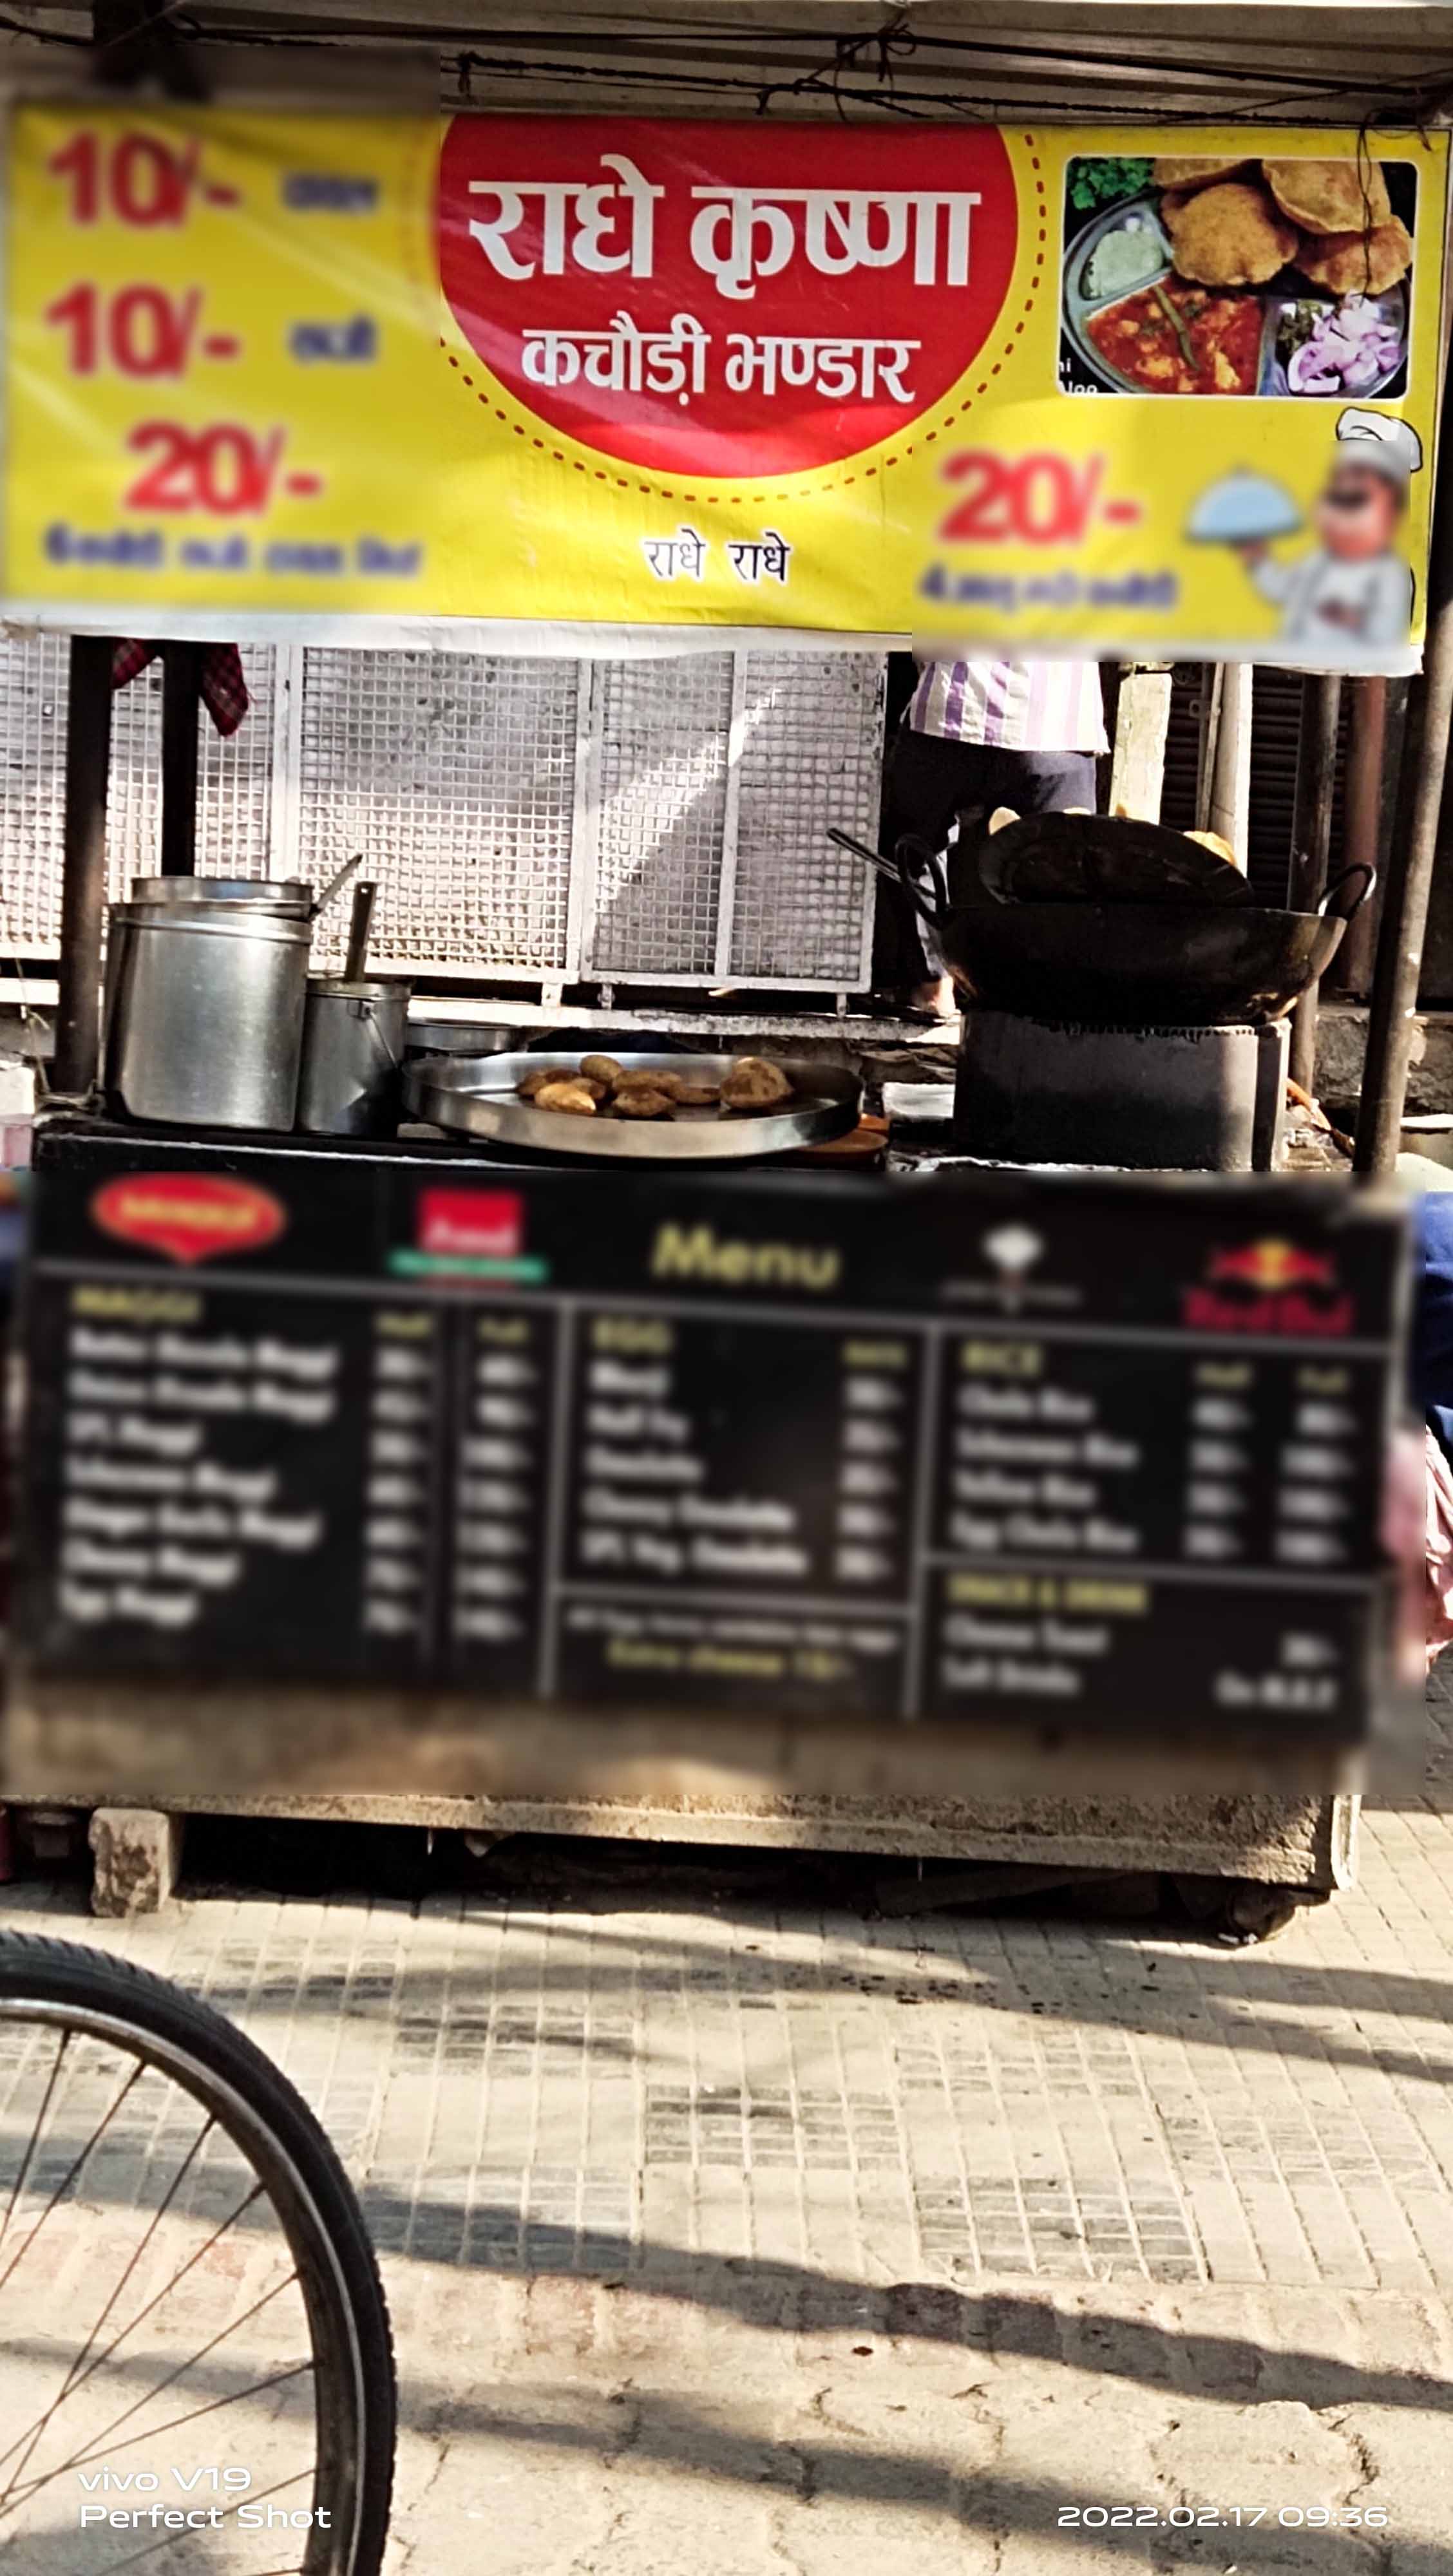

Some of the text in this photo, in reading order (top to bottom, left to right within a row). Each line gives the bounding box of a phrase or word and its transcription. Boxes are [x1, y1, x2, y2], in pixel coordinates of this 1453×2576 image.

[468, 154, 982, 300] राधे कृष्णा
[520, 310, 922, 406] कचौड़ी भण्डार
[647, 530, 791, 581] राधे राधे
